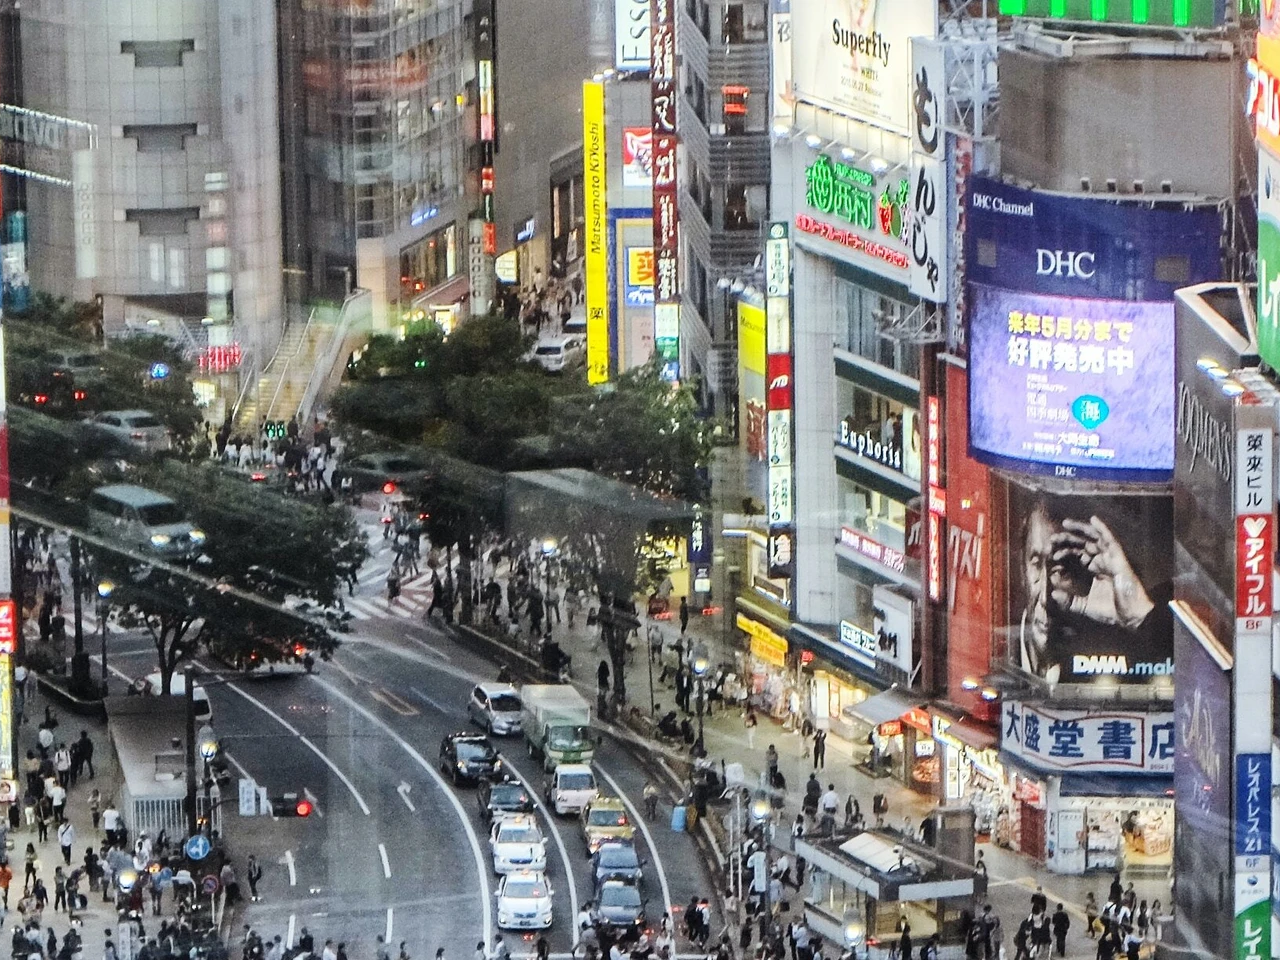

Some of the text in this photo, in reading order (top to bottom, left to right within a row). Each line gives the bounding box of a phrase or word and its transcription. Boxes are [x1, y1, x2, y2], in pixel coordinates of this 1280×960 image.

[832, 18, 891, 67] Superfly
[912, 66, 939, 293] もんじゃ
[973, 194, 1033, 217] DHC Channel
[1036, 248, 1095, 279] DHC
[1008, 311, 1133, 342] 来年5月分まで
[1007, 336, 1133, 375] 好評発売中
[840, 421, 901, 469] Euphoria
[1055, 465, 1077, 477] DHC
[1245, 537, 1266, 616] アイフル
[1006, 703, 1174, 761] 大盛堂書店
